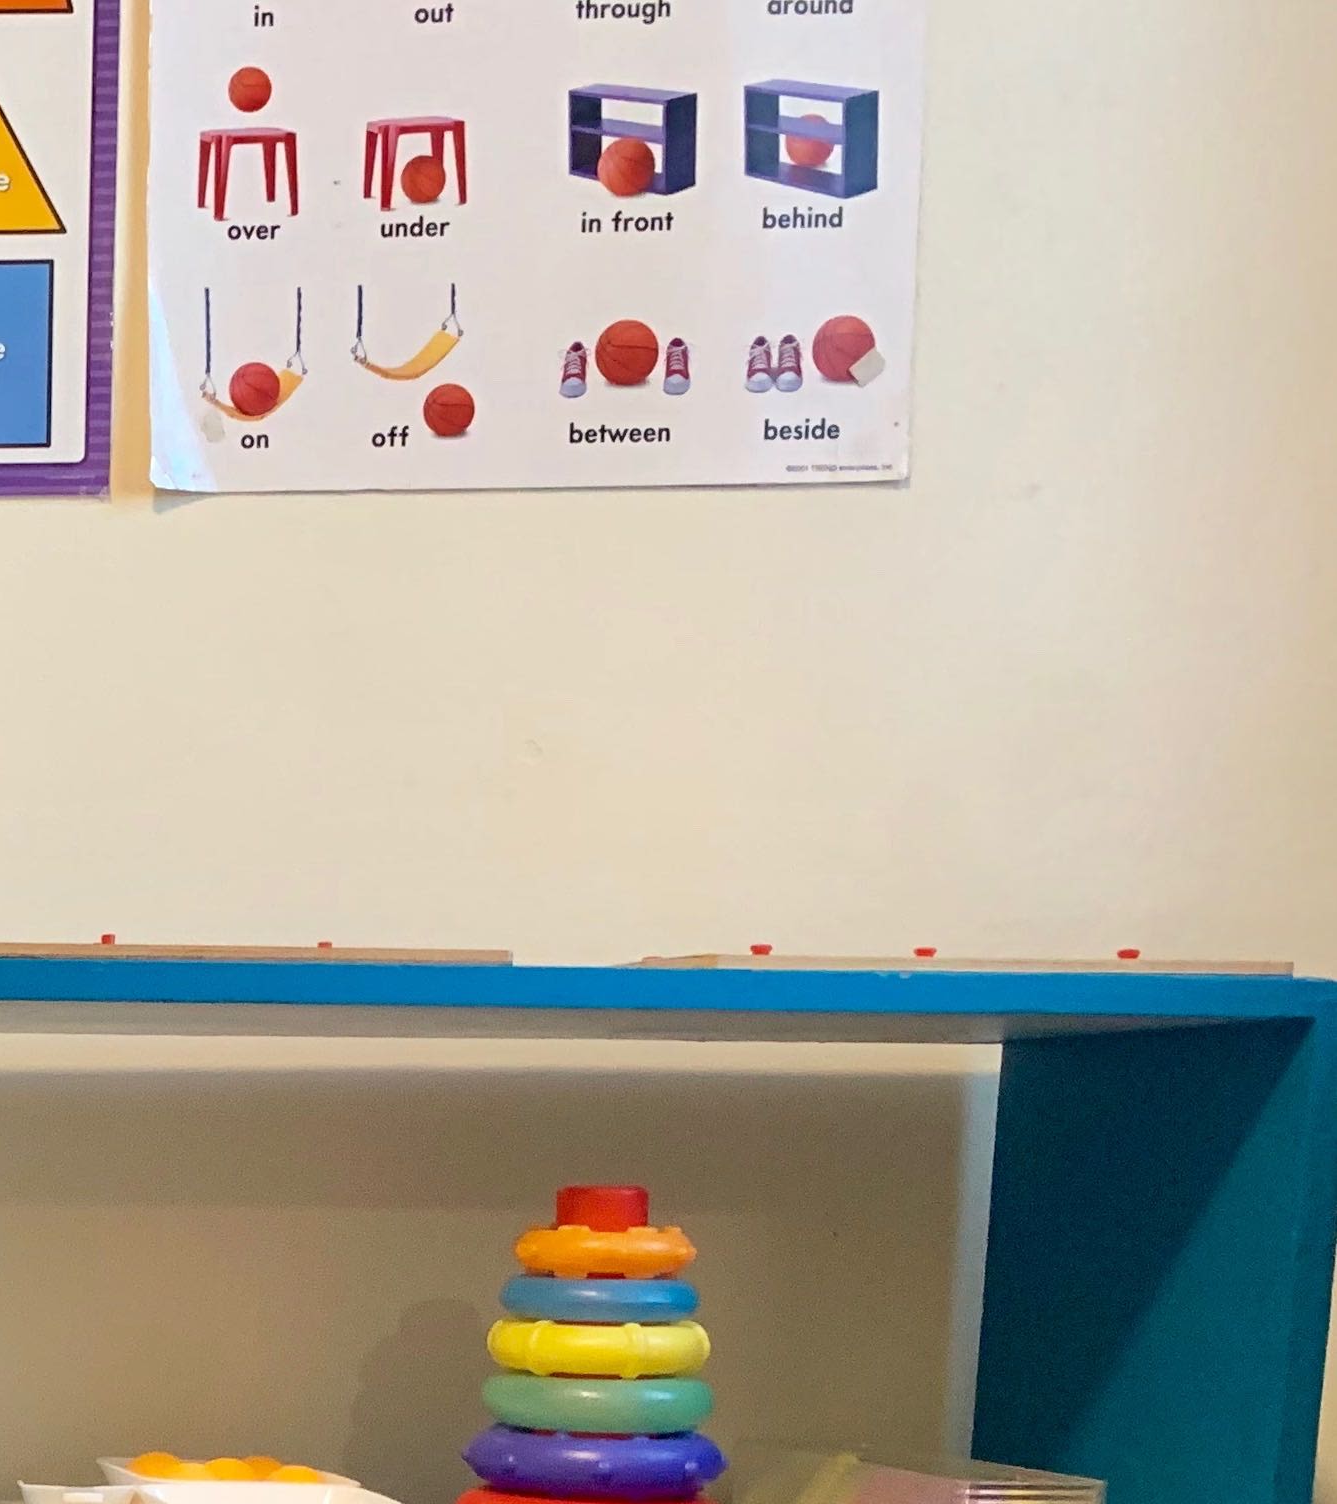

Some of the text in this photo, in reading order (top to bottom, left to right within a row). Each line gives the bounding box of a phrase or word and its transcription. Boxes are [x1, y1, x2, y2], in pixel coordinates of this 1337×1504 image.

[254, 5, 274, 27] in
[414, 3, 454, 23] out
[575, 0, 671, 25] through
[380, 216, 451, 238] under
[581, 211, 674, 233] in front
[762, 206, 843, 229] behind
[227, 222, 281, 241] over
[371, 425, 410, 448] off
[569, 422, 671, 444] between
[764, 418, 840, 441] beside
[240, 434, 269, 449] on
